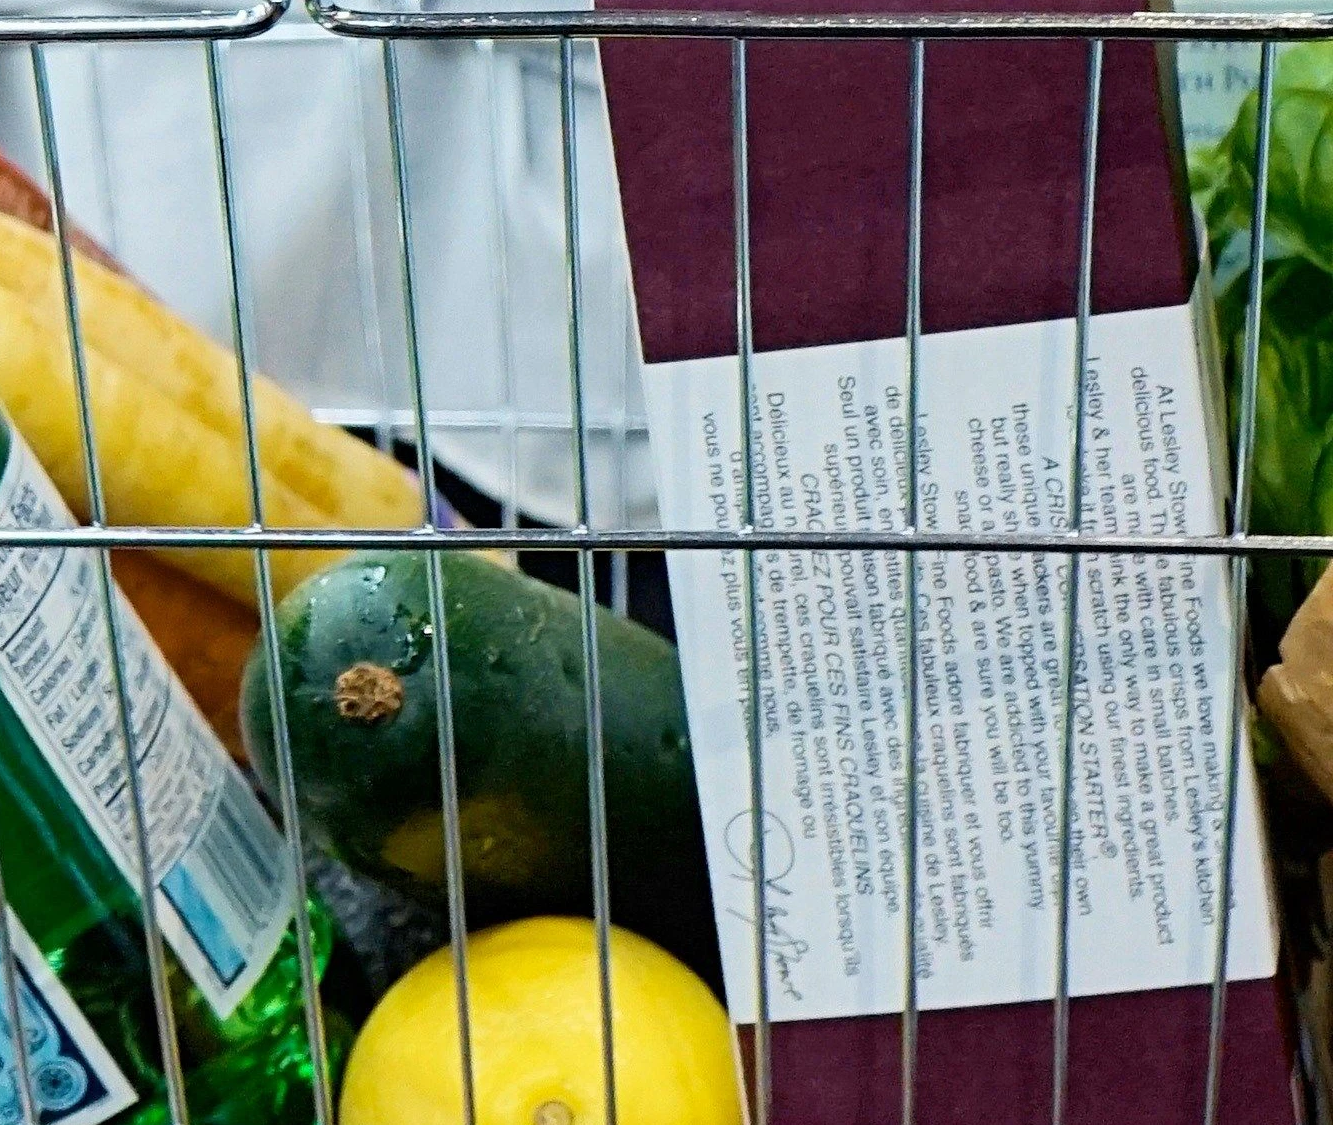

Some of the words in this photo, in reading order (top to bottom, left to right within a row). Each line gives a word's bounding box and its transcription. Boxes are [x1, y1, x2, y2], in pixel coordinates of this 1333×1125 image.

[838, 375, 859, 418] Seul
[1130, 366, 1152, 451] delicious
[1156, 384, 1175, 405] At
[702, 412, 718, 457] vous
[767, 391, 790, 479] Délicieux
[845, 425, 858, 448] un
[864, 404, 881, 449] avec
[991, 416, 1009, 447] but
[1012, 402, 1030, 456] these
[1092, 426, 1109, 440] &
[1159, 411, 1181, 474] Lesley
[968, 417, 988, 488] cheese
[1042, 456, 1060, 470] A
[1095, 447, 1112, 478] her
[709, 464, 722, 487] ne
[749, 431, 778, 562] accompags
[780, 486, 794, 510] au
[844, 456, 873, 521] produit
[870, 456, 890, 500] soin,
[996, 453, 1016, 504] really
[1019, 463, 1039, 527] unique
[1121, 473, 1137, 504] are
[1142, 457, 1163, 505] food.
[800, 472, 831, 579] CRAEZ
[877, 507, 891, 530] en
[921, 482, 943, 530] Stow
[954, 489, 976, 534] snac
[978, 494, 991, 513] or
[1044, 477, 1068, 533] CRIS
[1099, 485, 1117, 534] team
[784, 516, 808, 587] nrel,
[1003, 510, 1021, 561] she
[1126, 511, 1145, 564] mae
[1148, 509, 1168, 570] The
[768, 569, 785, 593] de
[858, 527, 878, 596] aison
[883, 549, 903, 600] etites
[981, 520, 1007, 611] apasto.
[1031, 550, 1052, 615] ackers
[1108, 552, 1128, 587] ink
[1178, 554, 1195, 590] ine
[719, 572, 741, 610] plus
[835, 551, 863, 619] pouvait
[969, 599, 986, 612] &
[1011, 567, 1029, 619] when
[1087, 569, 1111, 637] scratch
[1134, 571, 1154, 610] with
[794, 593, 809, 626] ces
[815, 583, 840, 647] POUR
[885, 385, 902, 409] de
[918, 637, 940, 716] fabuleux
[930, 723, 955, 821] craquelins
[944, 828, 965, 867] sont
[936, 596, 958, 655] Foods
[1114, 593, 1131, 623] the
[1157, 575, 1179, 657] fabulous
[1183, 596, 1205, 656] Foods
[868, 603, 894, 679] fabriqué
[972, 620, 986, 650] are
[994, 616, 1012, 648] We
[1040, 620, 1055, 651] are
[1118, 629, 1137, 669] only
[1140, 616, 1157, 658] care
[825, 652, 847, 697] CES
[849, 627, 873, 711] satisfaire
[977, 657, 993, 698] sure
[999, 655, 1014, 684] are
[1016, 625, 1041, 690] topped
[1096, 643, 1115, 695] using
[1146, 664, 1162, 681] in
[1192, 663, 1207, 689] we
[799, 632, 825, 729] craquelins
[944, 660, 963, 716] adore
[1123, 674, 1140, 712] way
[1168, 662, 1187, 720] crisps
[785, 701, 802, 725] de
[831, 701, 854, 751] FINS
[879, 686, 896, 730] avec
[979, 705, 998, 739] you
[1027, 695, 1047, 733] with
[1104, 701, 1119, 730] our
[1130, 718, 1146, 736] to
[1149, 688, 1171, 739] small
[1196, 696, 1213, 735] love
[861, 718, 881, 779] Lesley
[886, 736, 903, 770] des
[1004, 691, 1030, 772] addicted
[1176, 725, 1193, 768] from
[790, 731, 811, 809] fromage
[813, 736, 834, 776] sont
[952, 721, 974, 805] fabriquer
[988, 745, 1007, 774] will
[1029, 740, 1049, 781] your
[1109, 736, 1131, 788] finest
[1133, 742, 1154, 794] make
[1202, 742, 1224, 811] making
[870, 786, 887, 802] et
[993, 781, 1010, 804] be
[1016, 778, 1032, 796] to
[1140, 801, 1153, 812] a
[1156, 745, 1179, 825] batches.
[801, 815, 815, 839] ou
[839, 756, 874, 896] CRAQUELINS
[873, 807, 888, 842] son
[964, 812, 982, 829] et
[1019, 803, 1037, 834] this
[1183, 775, 1207, 852] Lesley's
[968, 837, 984, 880] vous
[1139, 818, 1165, 866] great
[923, 853, 941, 877] de
[1020, 842, 1044, 910] yummy
[974, 886, 995, 928] offrir
[1074, 877, 1090, 916] own
[1146, 873, 1175, 945] product
[1193, 857, 1215, 926] kitchen
